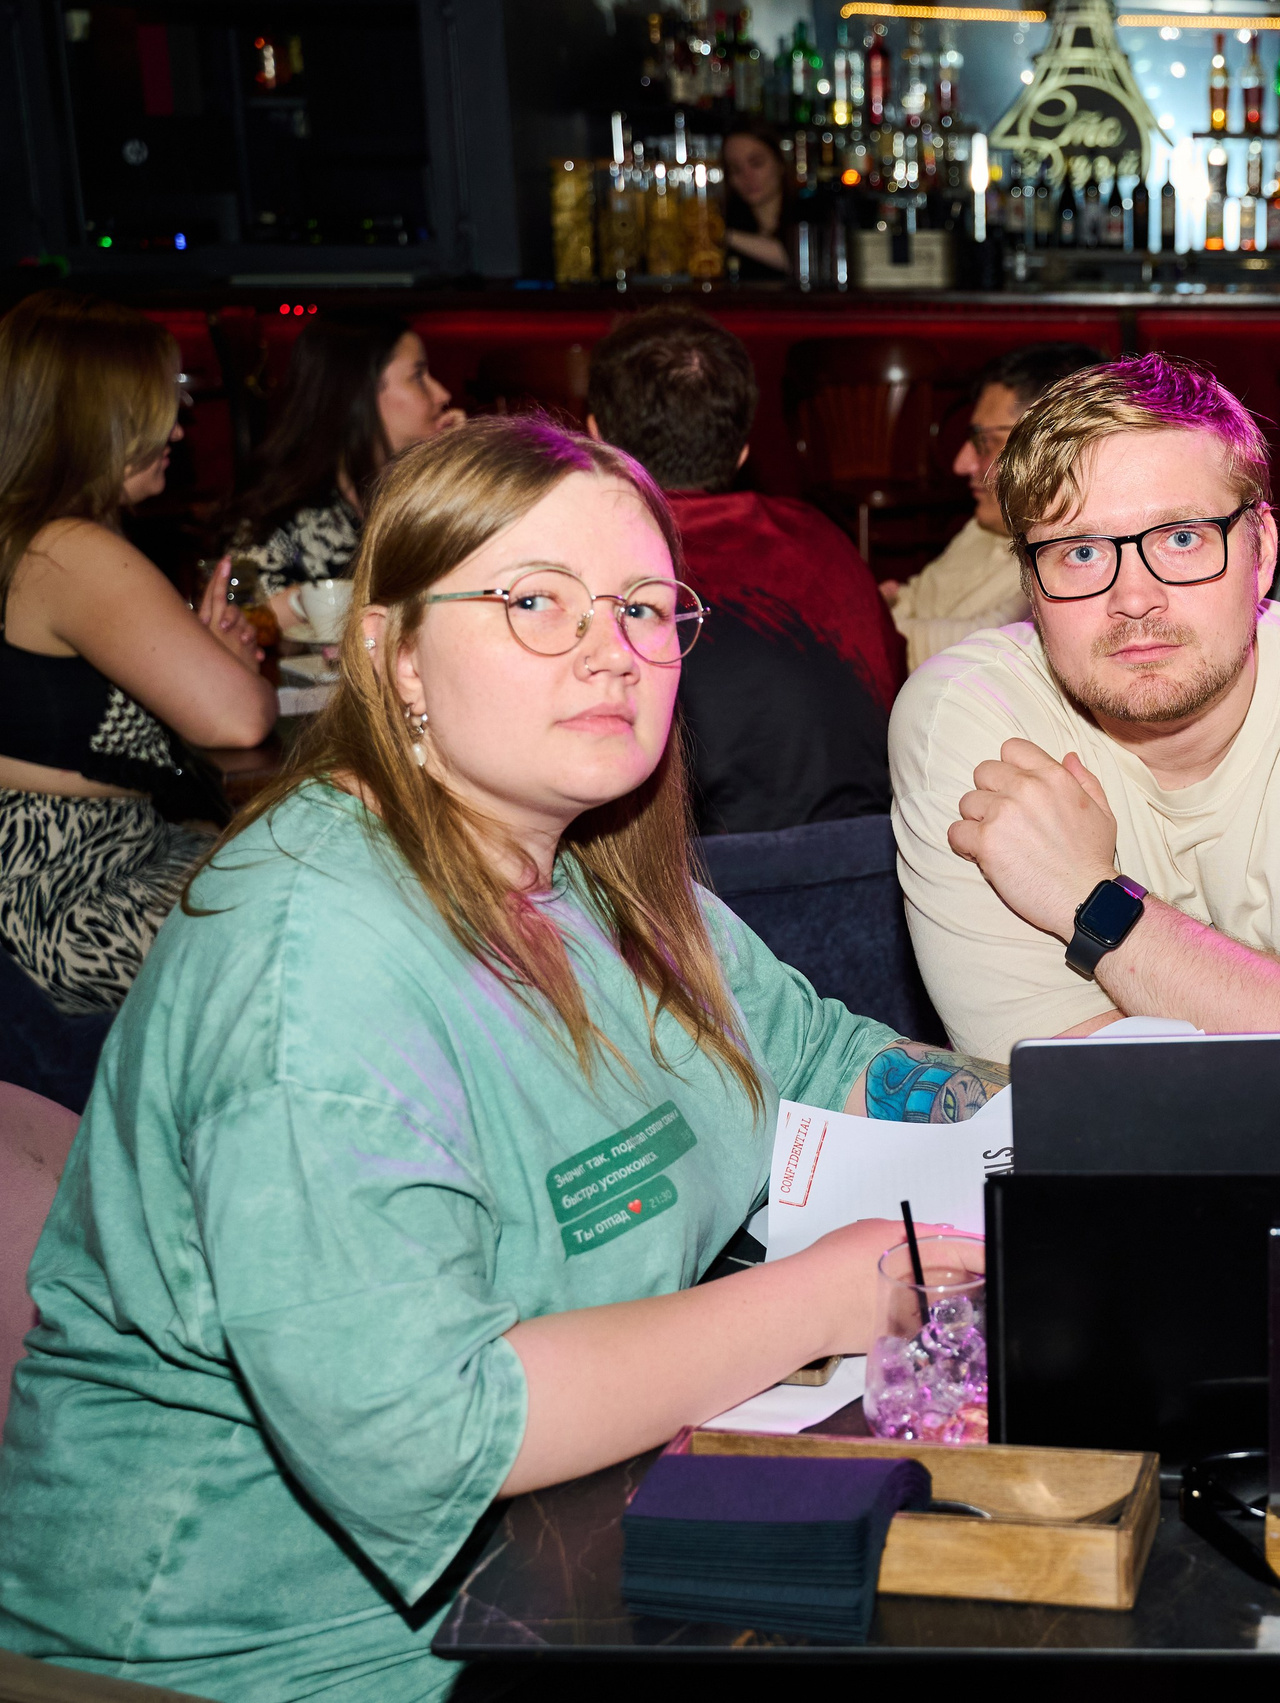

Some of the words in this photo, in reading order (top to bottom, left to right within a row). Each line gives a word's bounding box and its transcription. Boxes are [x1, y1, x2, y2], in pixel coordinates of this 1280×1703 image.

[554, 1163, 586, 1188] Значит
[586, 1152, 611, 1170] так,
[780, 1117, 812, 1193] CONFIDENTIAL
[561, 1181, 599, 1209] быстро
[573, 1229, 595, 1243] Ты
[595, 1210, 631, 1234] отпад
[650, 1189, 673, 1209] 21:30
